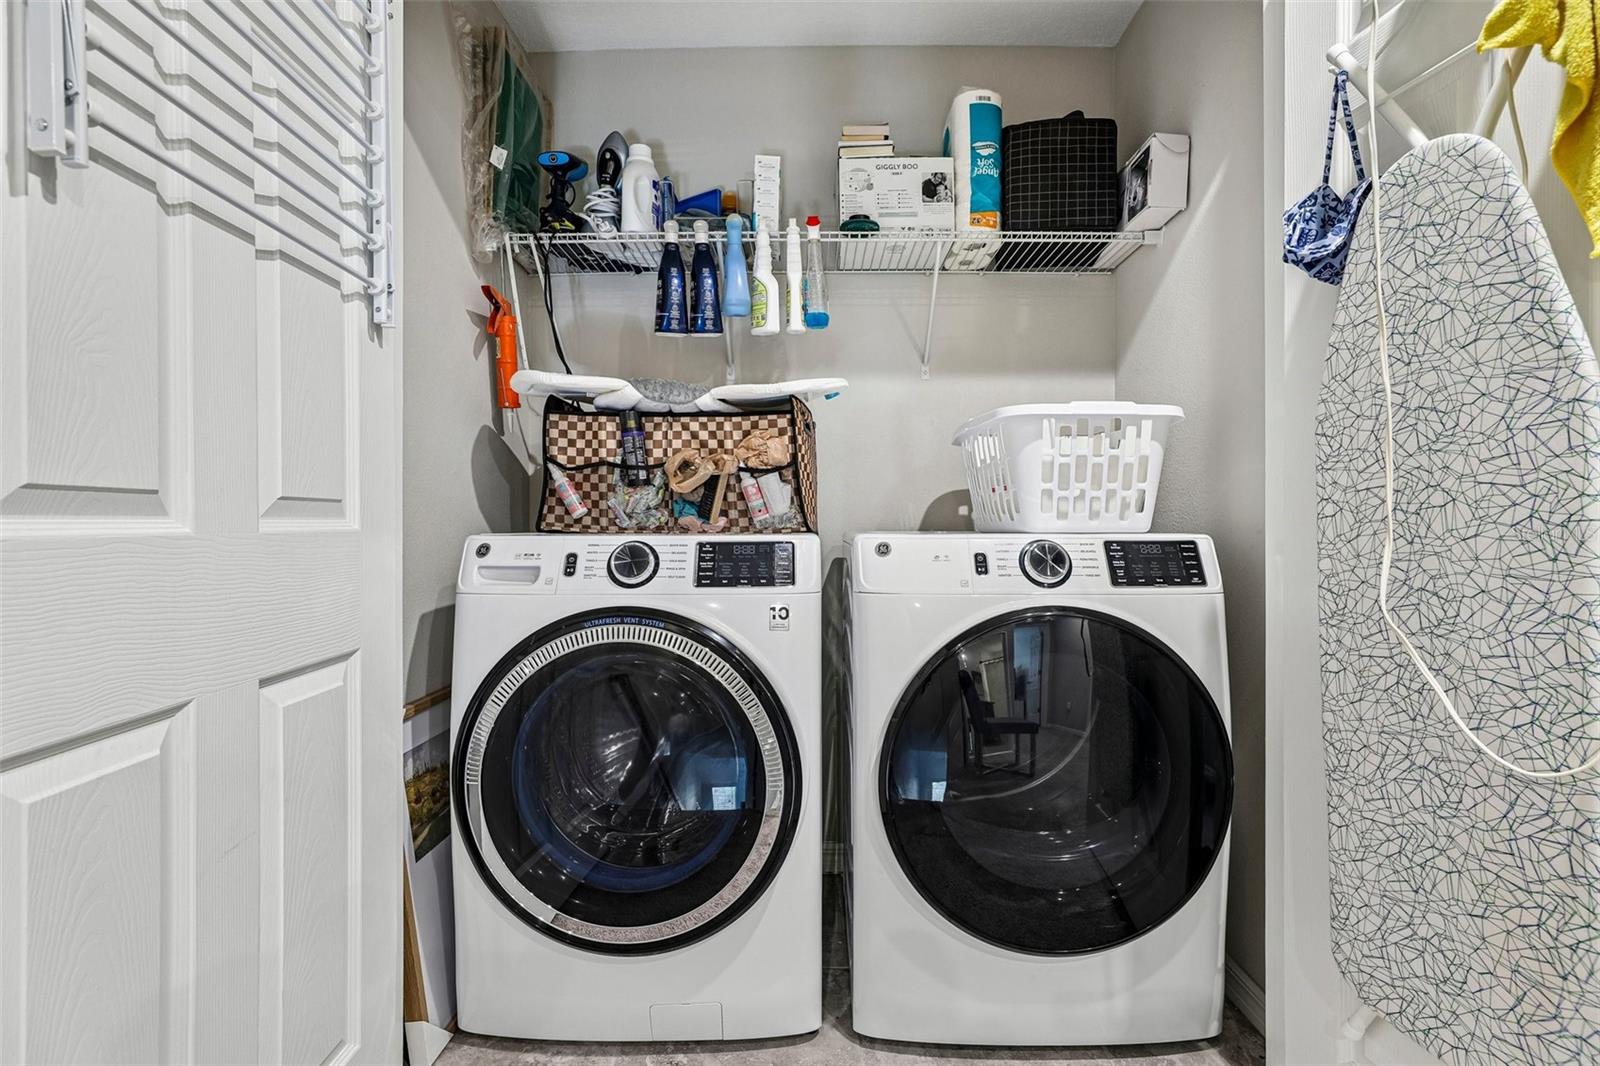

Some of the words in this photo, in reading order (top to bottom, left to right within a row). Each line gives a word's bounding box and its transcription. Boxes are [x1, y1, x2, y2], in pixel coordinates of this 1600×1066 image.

[977, 158, 994, 168] Soft
[973, 167, 999, 178] Angel
[769, 606, 790, 620] 10
[584, 617, 621, 628] ULTRAFRESH
[642, 619, 666, 628] SYSTEM
